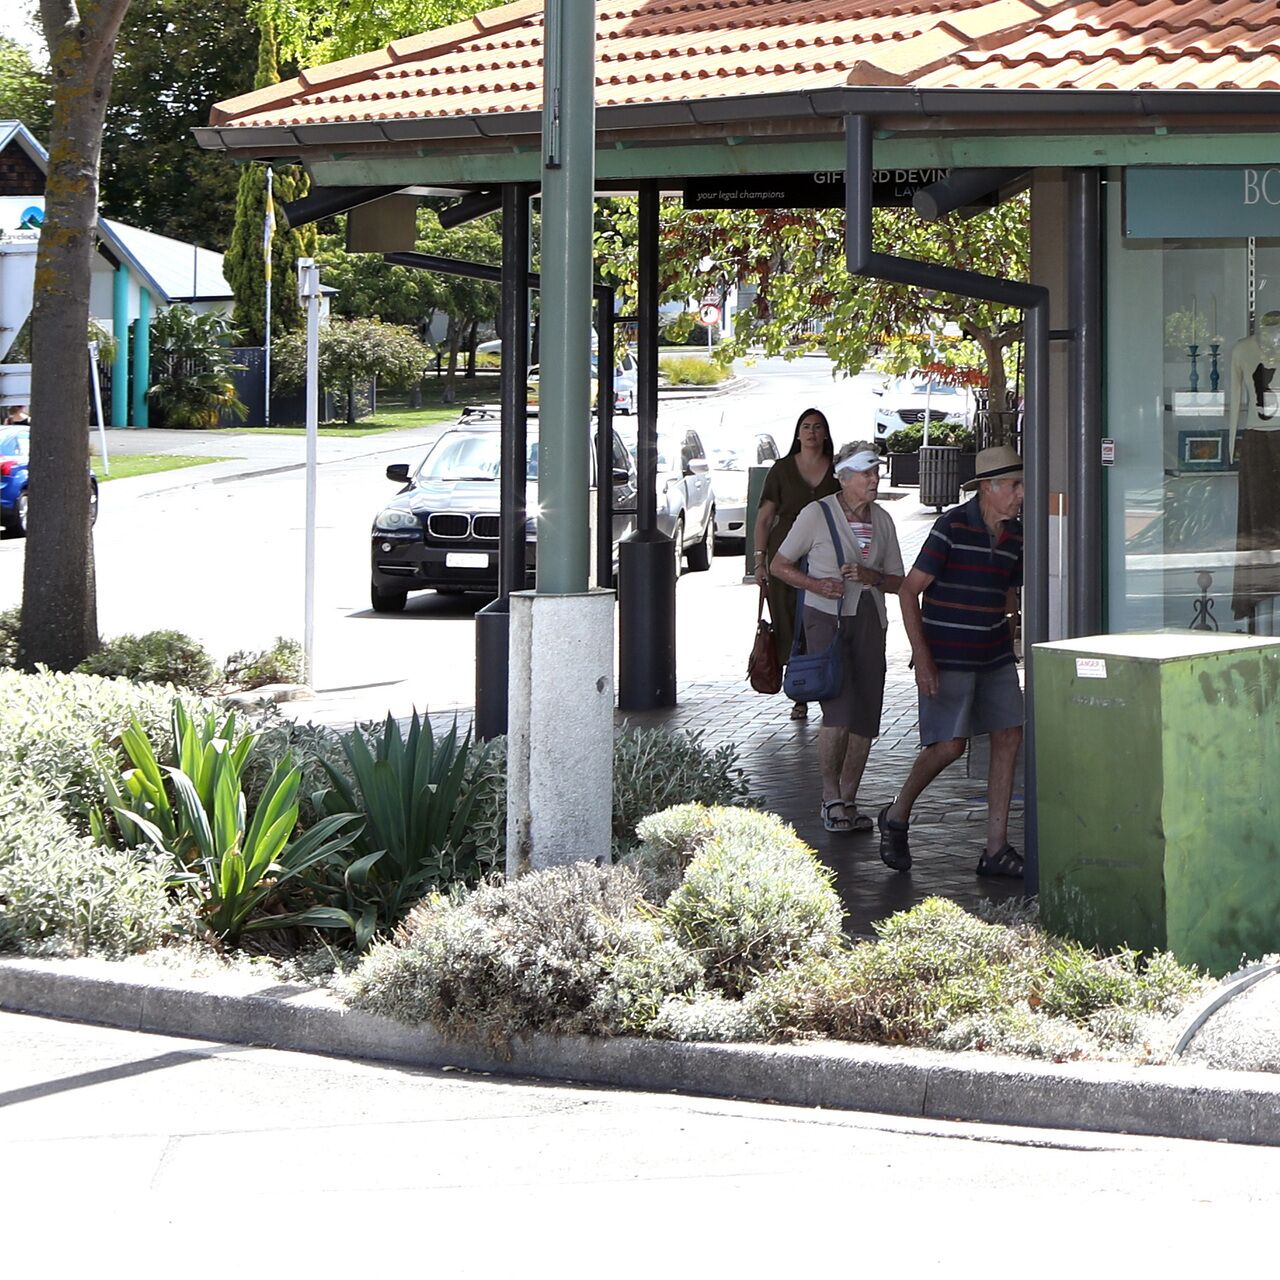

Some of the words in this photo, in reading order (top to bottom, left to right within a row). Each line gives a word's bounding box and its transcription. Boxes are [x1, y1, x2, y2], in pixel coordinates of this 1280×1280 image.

[813, 171, 891, 184] GIFRD
[697, 192, 718, 201] your
[718, 190, 739, 201] legal
[739, 190, 786, 200] champions
